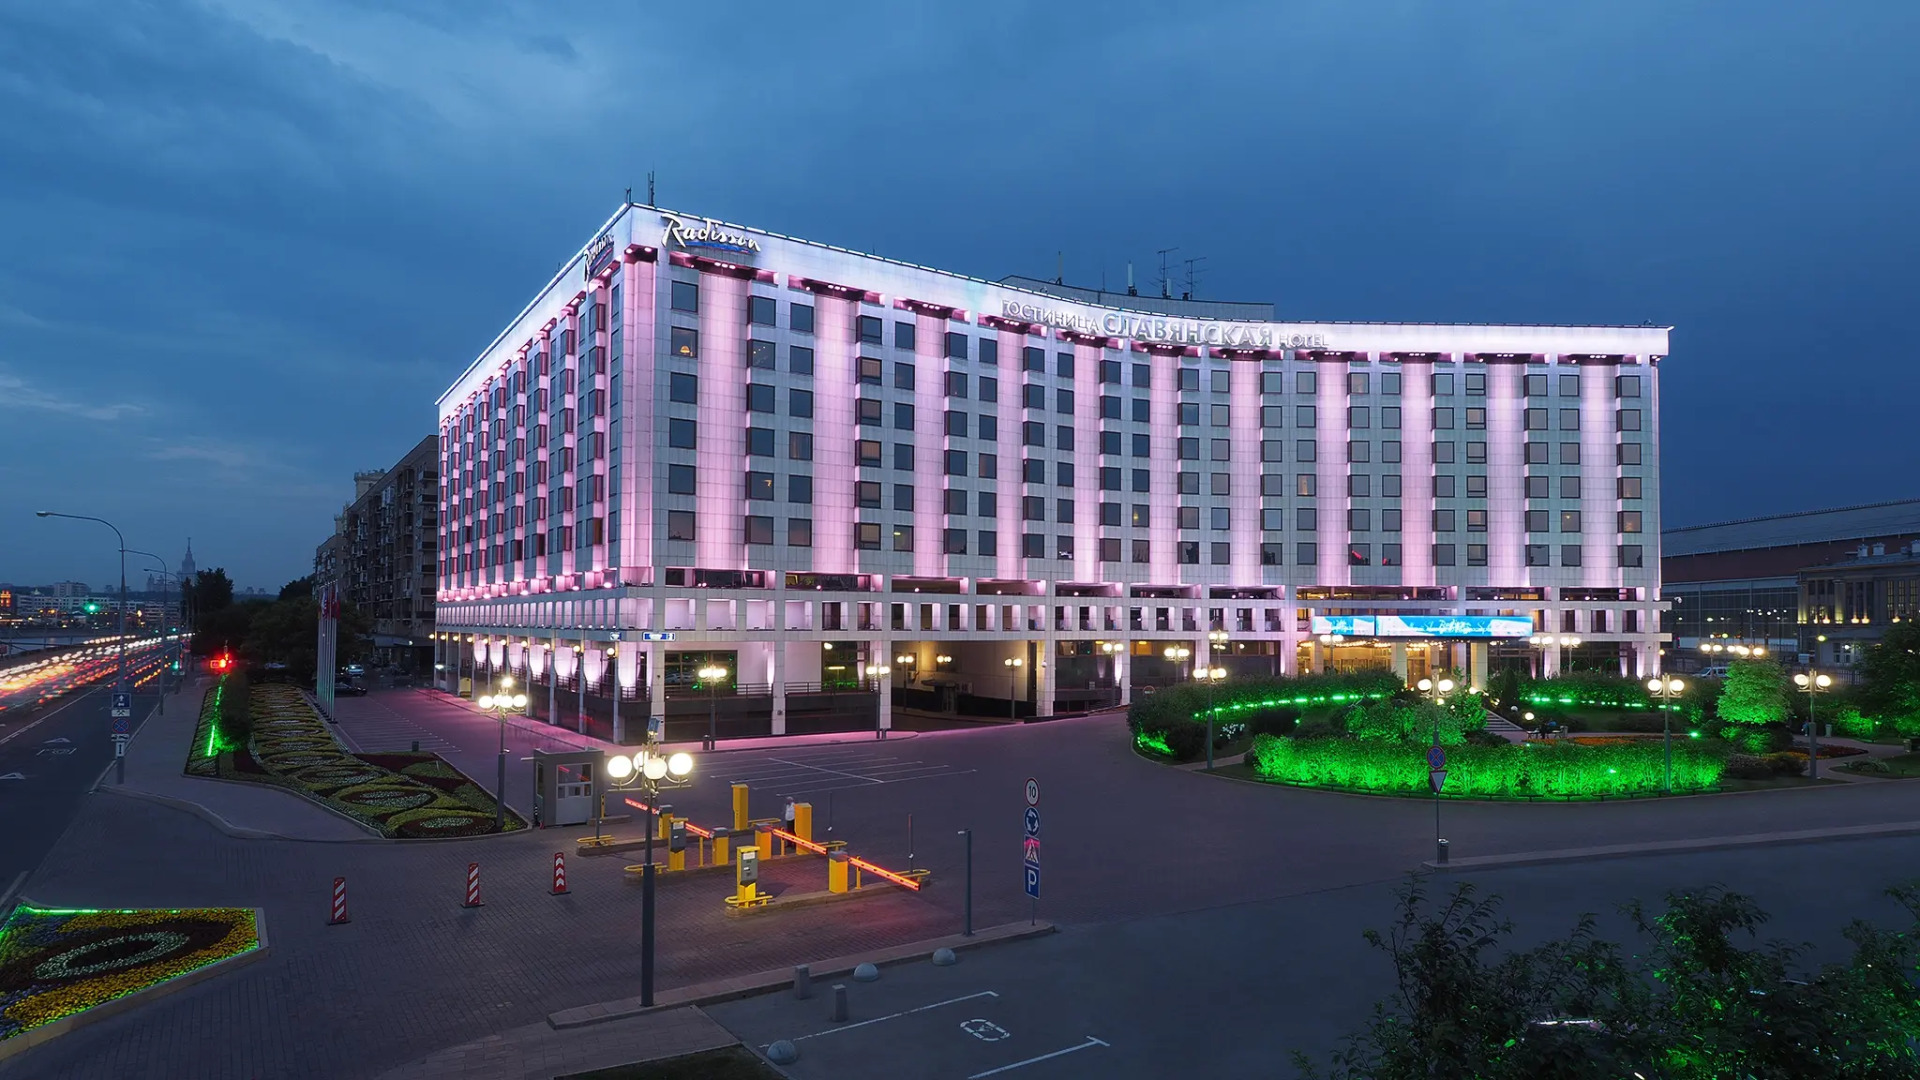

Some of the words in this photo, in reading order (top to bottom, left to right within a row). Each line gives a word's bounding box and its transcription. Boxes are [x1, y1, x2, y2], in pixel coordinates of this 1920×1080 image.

[661, 213, 761, 252] Radisson
[1001, 299, 1099, 334] ГОСТИНИЦА
[1101, 311, 1274, 347] СЛАВЯНСКАЯ
[1279, 333, 1329, 349] HOTEL
[1028, 785, 1037, 798] 10
[1028, 870, 1037, 893] P
